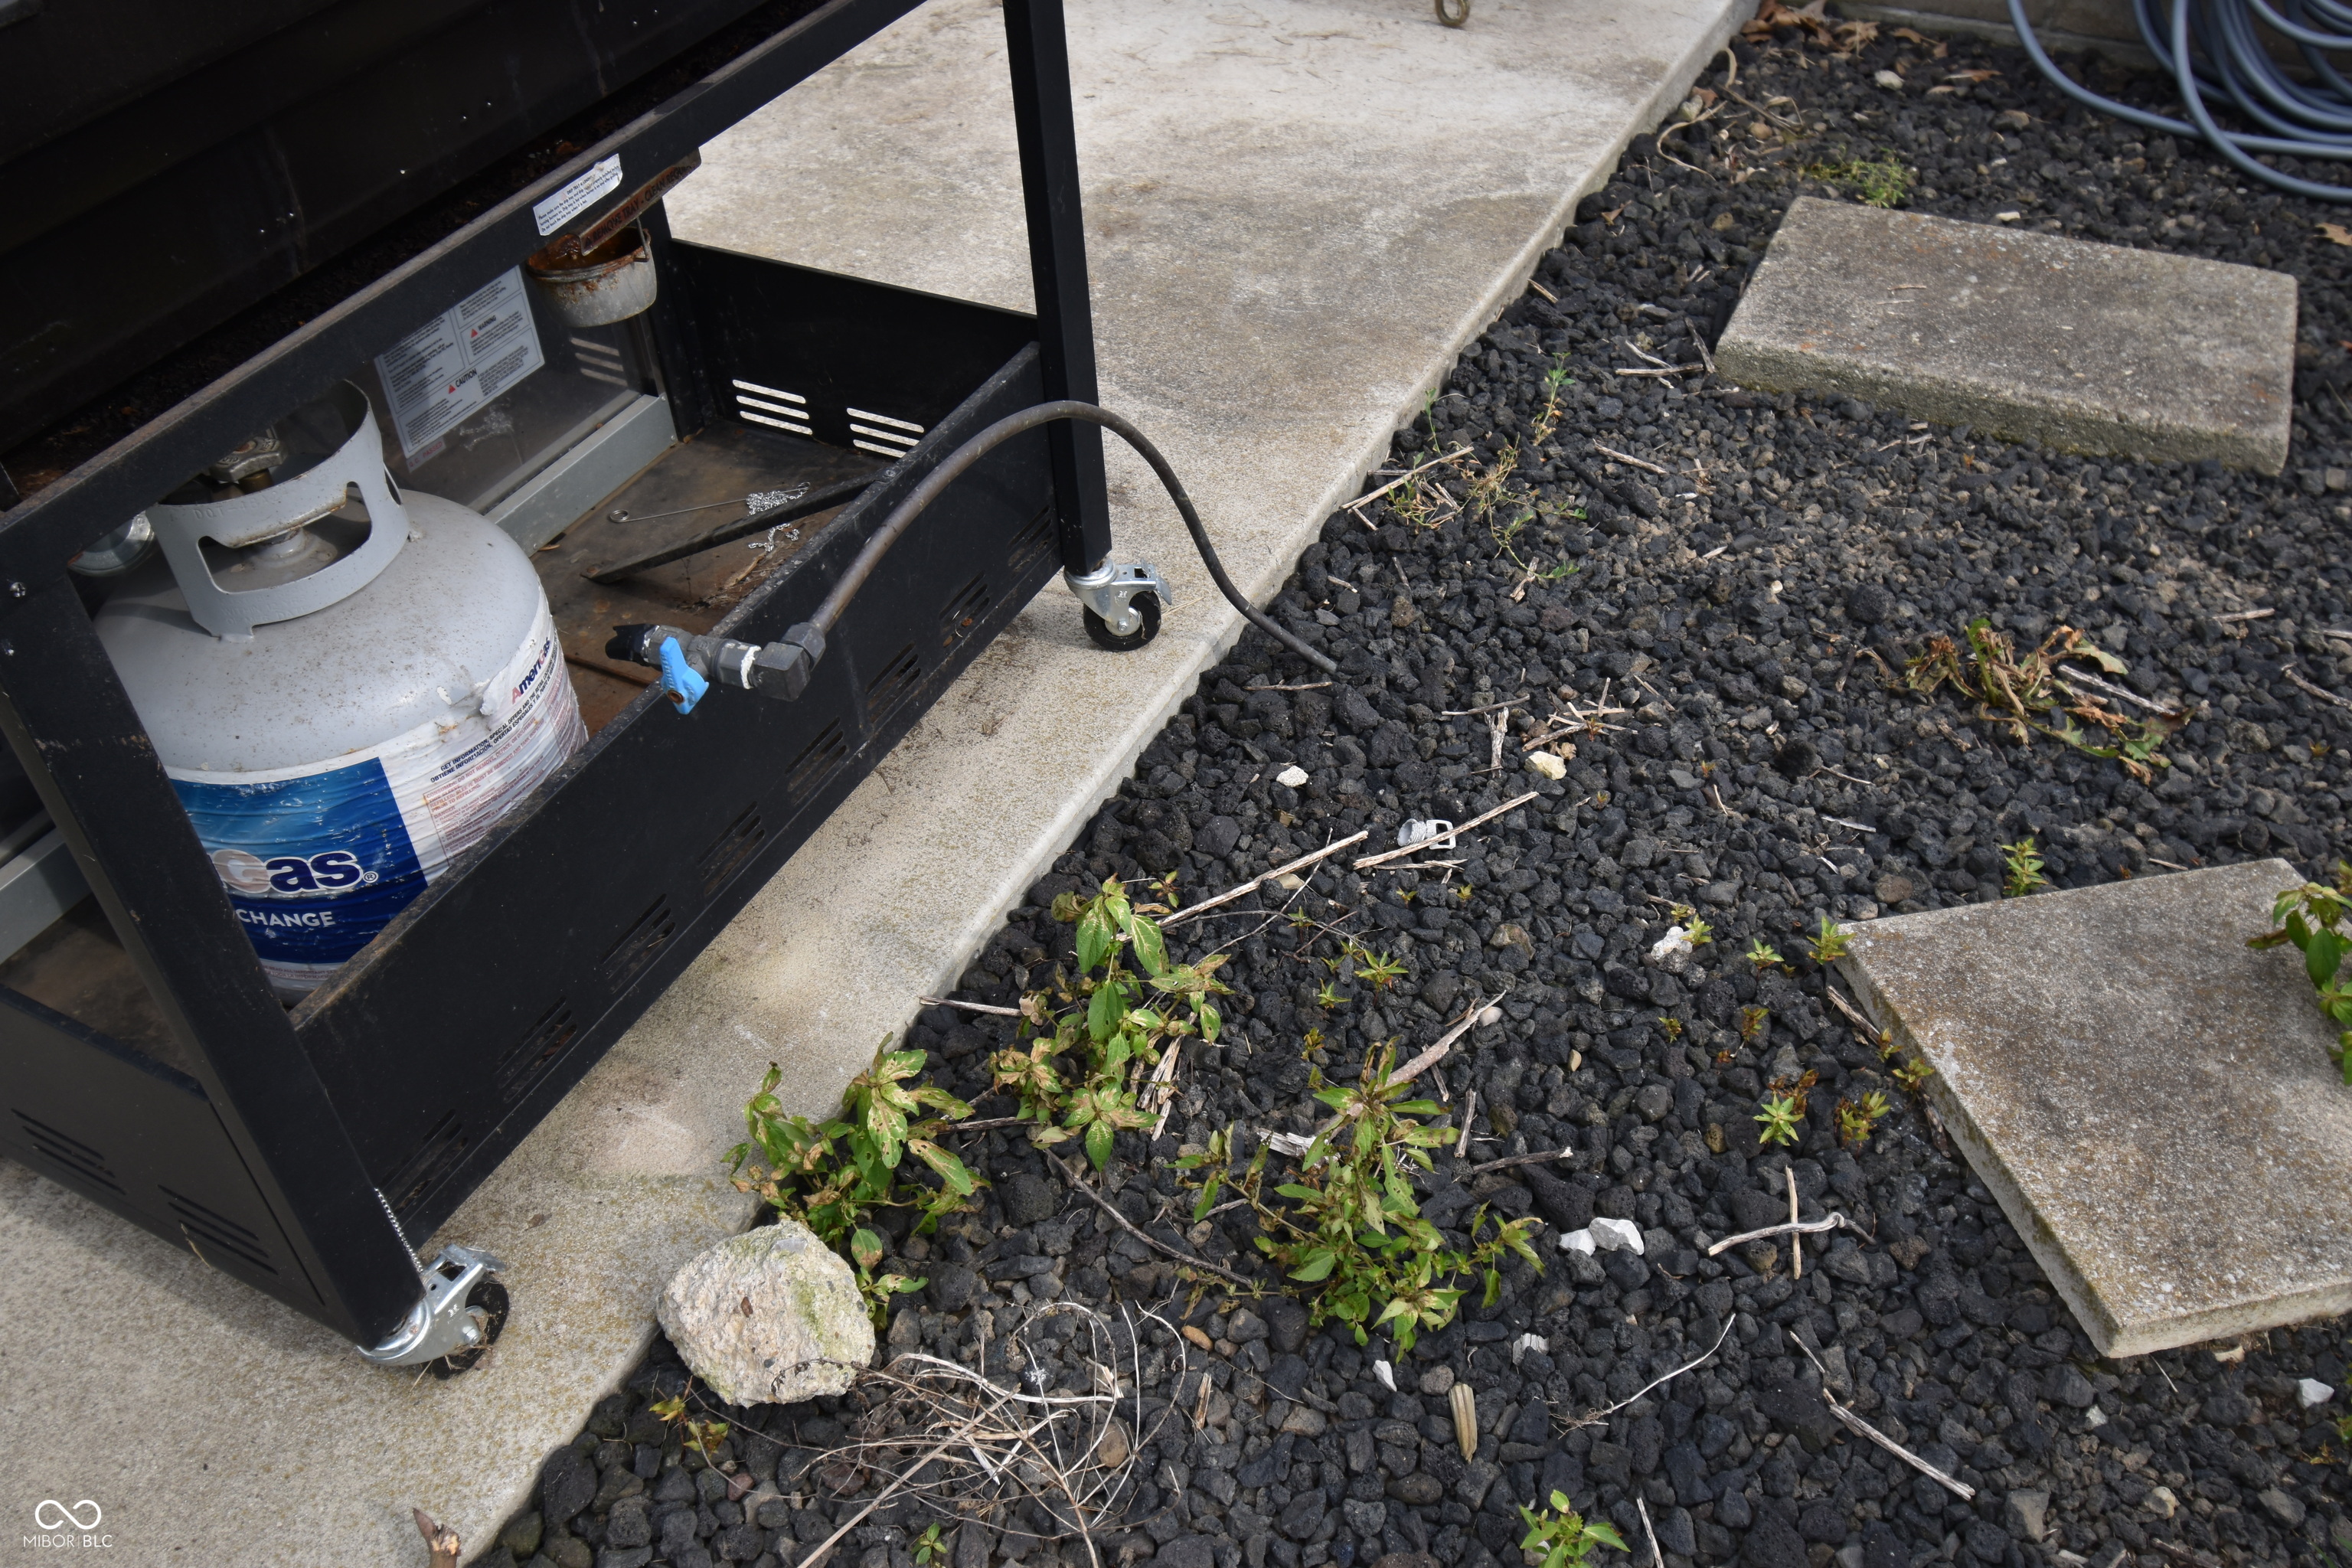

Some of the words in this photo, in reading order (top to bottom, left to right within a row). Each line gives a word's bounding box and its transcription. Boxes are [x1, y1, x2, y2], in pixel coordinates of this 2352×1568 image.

[623, 199, 640, 220] TRAY
[645, 179, 665, 201] CLEAN
[478, 315, 497, 332] WARNING
[455, 368, 477, 387] CAUTION
[423, 441, 443, 458] PASSED
[512, 637, 550, 704] AmeriGas
[441, 762, 451, 772] GET
[452, 738, 489, 765] INFORMATION,
[508, 708, 522, 724] OFFERS
[521, 701, 530, 711] AND
[535, 680, 544, 694] RETAIL
[430, 766, 456, 782] OBTIENE
[493, 725, 512, 744] OFERTAS
[512, 704, 534, 727] ESPECIALES
[494, 753, 513, 770] REMOVED
[521, 737, 530, 746] TANK
[466, 769, 475, 778] NOT
[475, 756, 496, 771] REMOVE,
[433, 805, 456, 818] DANGER
[235, 908, 336, 928] CHANGE
